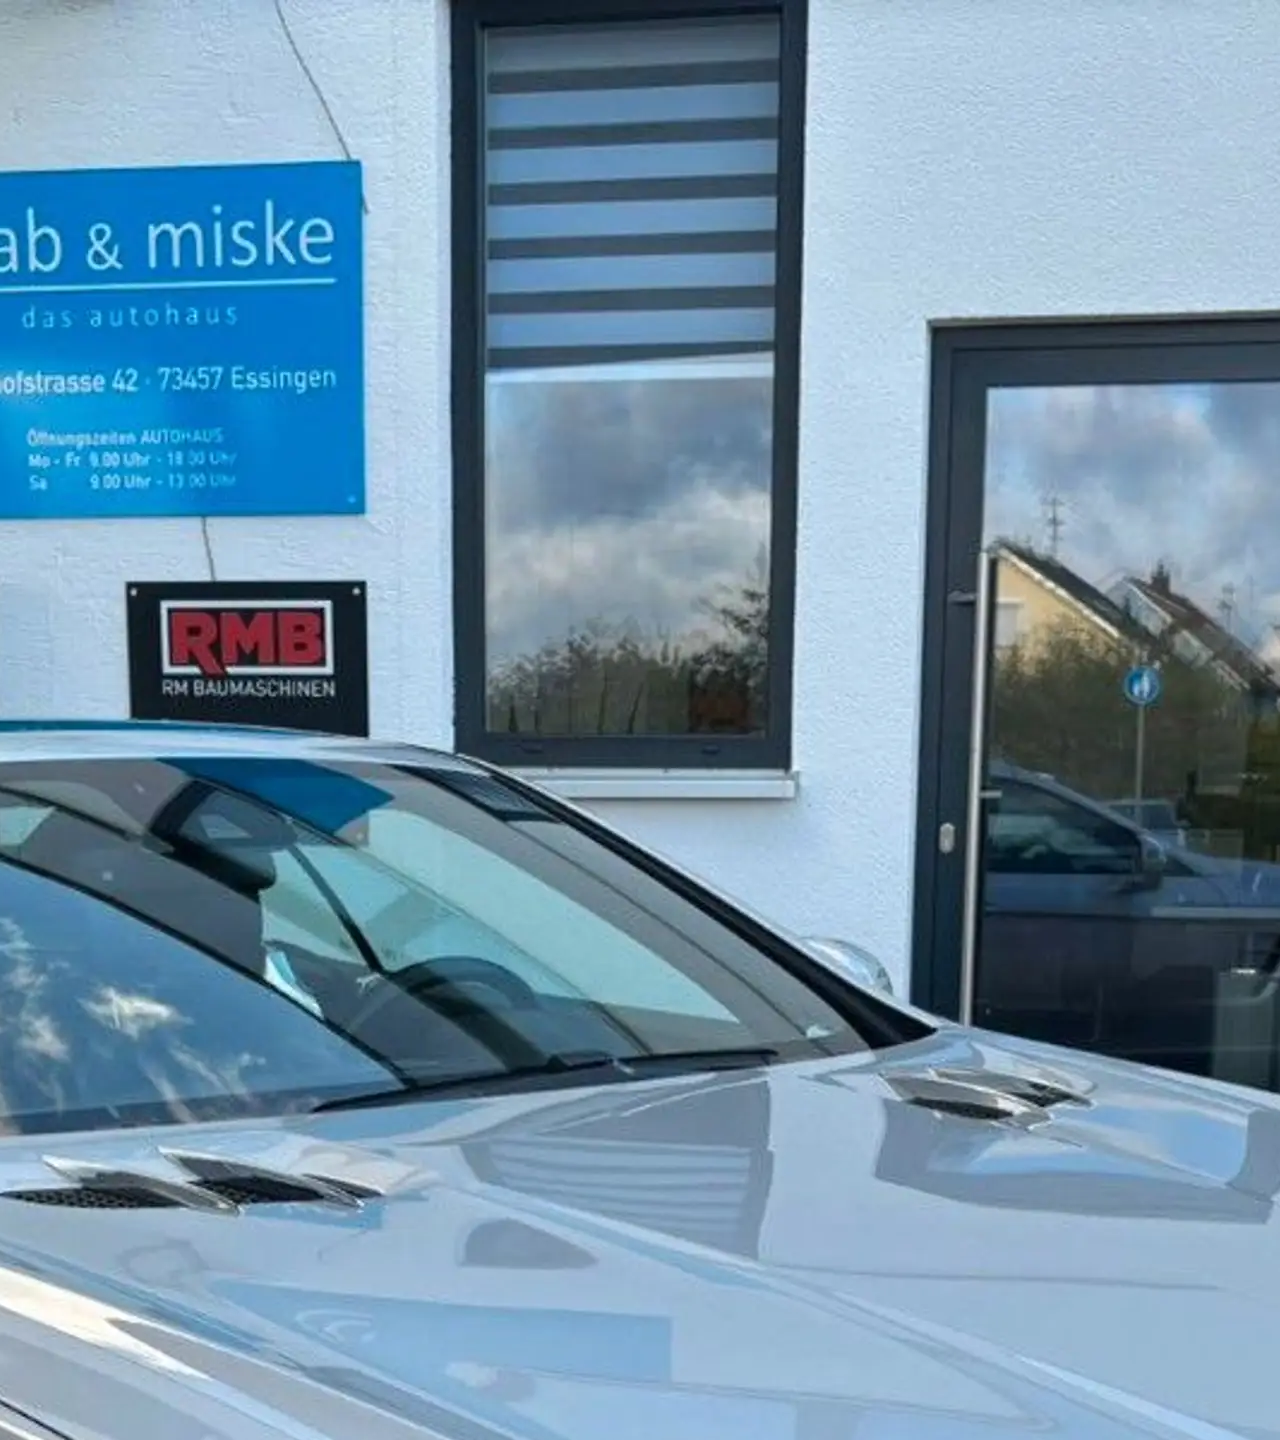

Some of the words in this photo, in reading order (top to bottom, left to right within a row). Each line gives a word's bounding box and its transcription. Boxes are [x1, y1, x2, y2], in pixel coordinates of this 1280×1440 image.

[86, 223, 123, 271] &
[147, 199, 335, 269] miske
[22, 306, 73, 328] das
[89, 303, 239, 328] autohaus
[111, 367, 139, 393] 42
[157, 366, 224, 392] 73457
[231, 365, 337, 395] Essingen
[139, 427, 225, 445] AUTOHAUS
[28, 453, 51, 468] Mo
[65, 453, 81, 467] Fr
[122, 452, 152, 467] Uhr
[29, 475, 49, 490] Sa
[123, 474, 152, 489] Uhr
[171, 611, 324, 675] RMB
[162, 679, 188, 696] RM
[192, 678, 336, 698] BAUMASCHINEN
